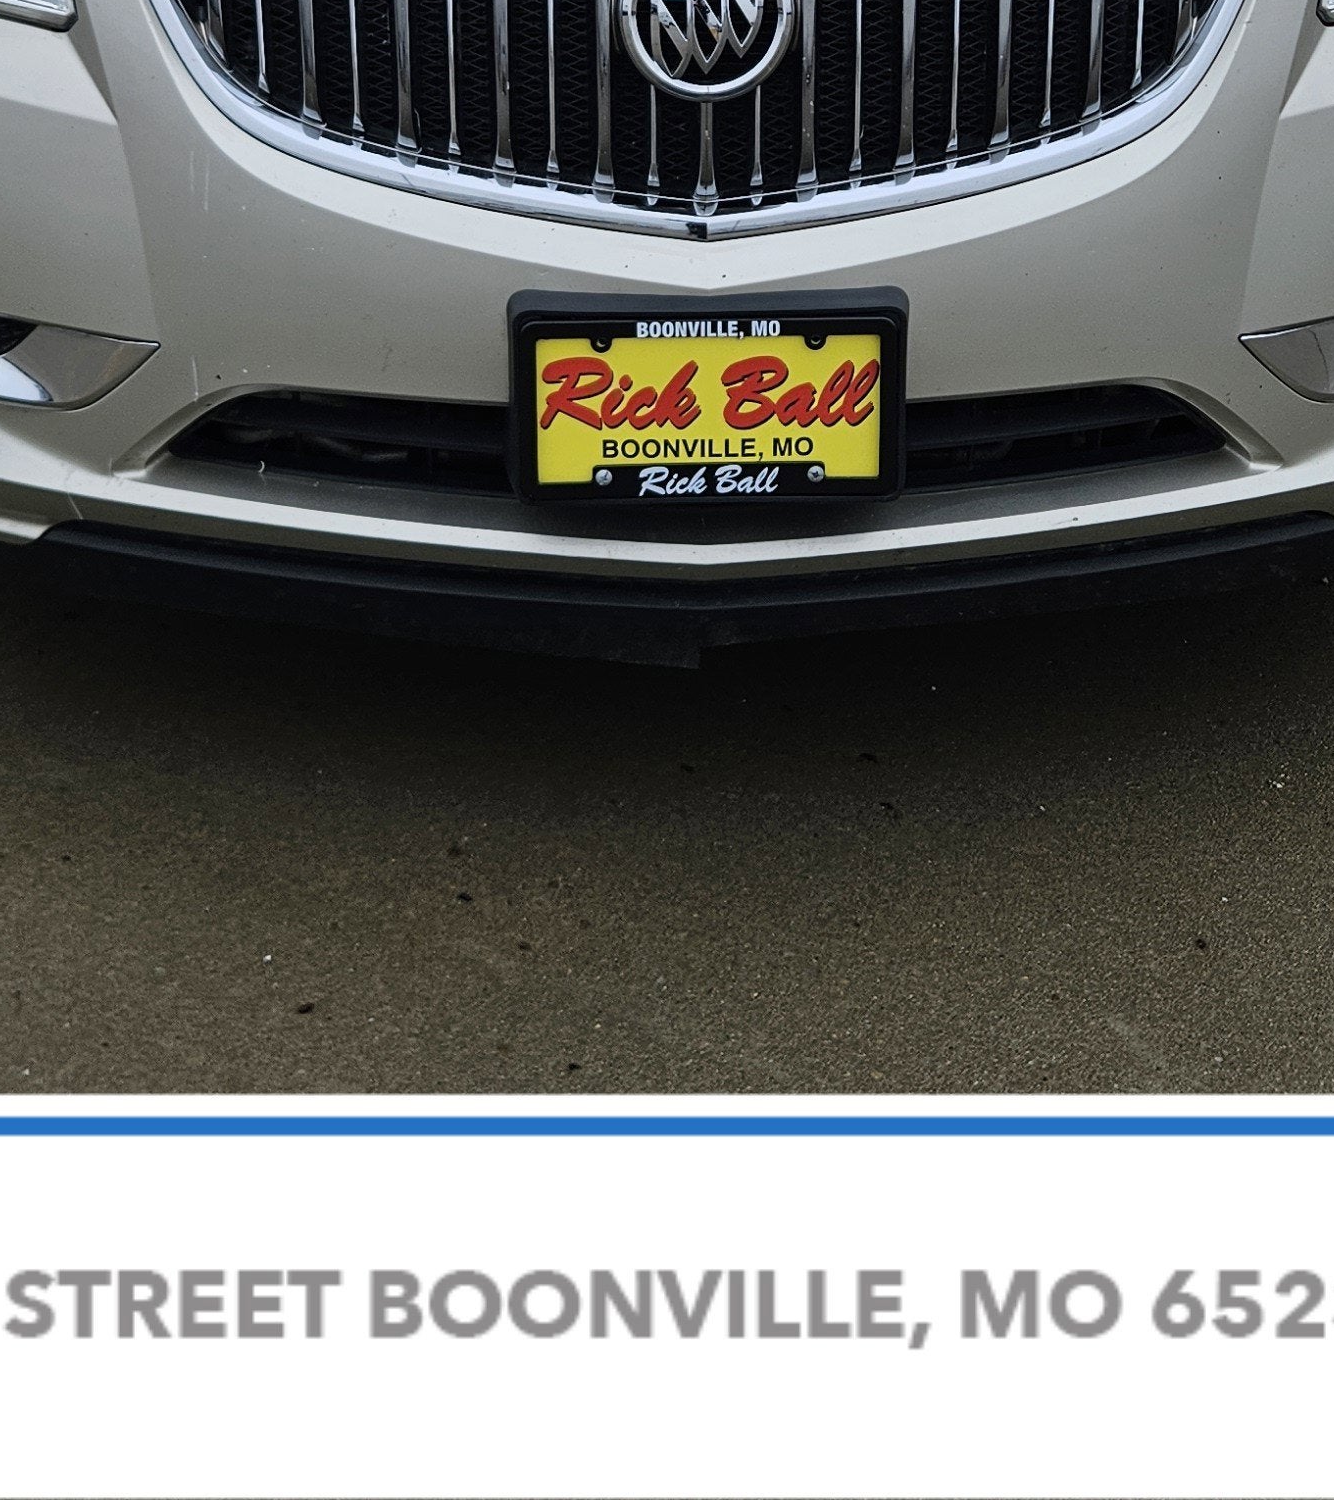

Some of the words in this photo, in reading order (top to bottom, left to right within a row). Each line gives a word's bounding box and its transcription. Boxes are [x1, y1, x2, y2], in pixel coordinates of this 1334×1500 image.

[636, 321, 744, 340] BOONVILLE,
[750, 320, 781, 338] MO
[540, 356, 701, 431] Rick
[721, 355, 880, 430] Ball
[602, 437, 764, 462] BOONVILLE,
[772, 436, 814, 458] MO
[638, 465, 708, 497] Rick
[715, 465, 780, 495] Ball
